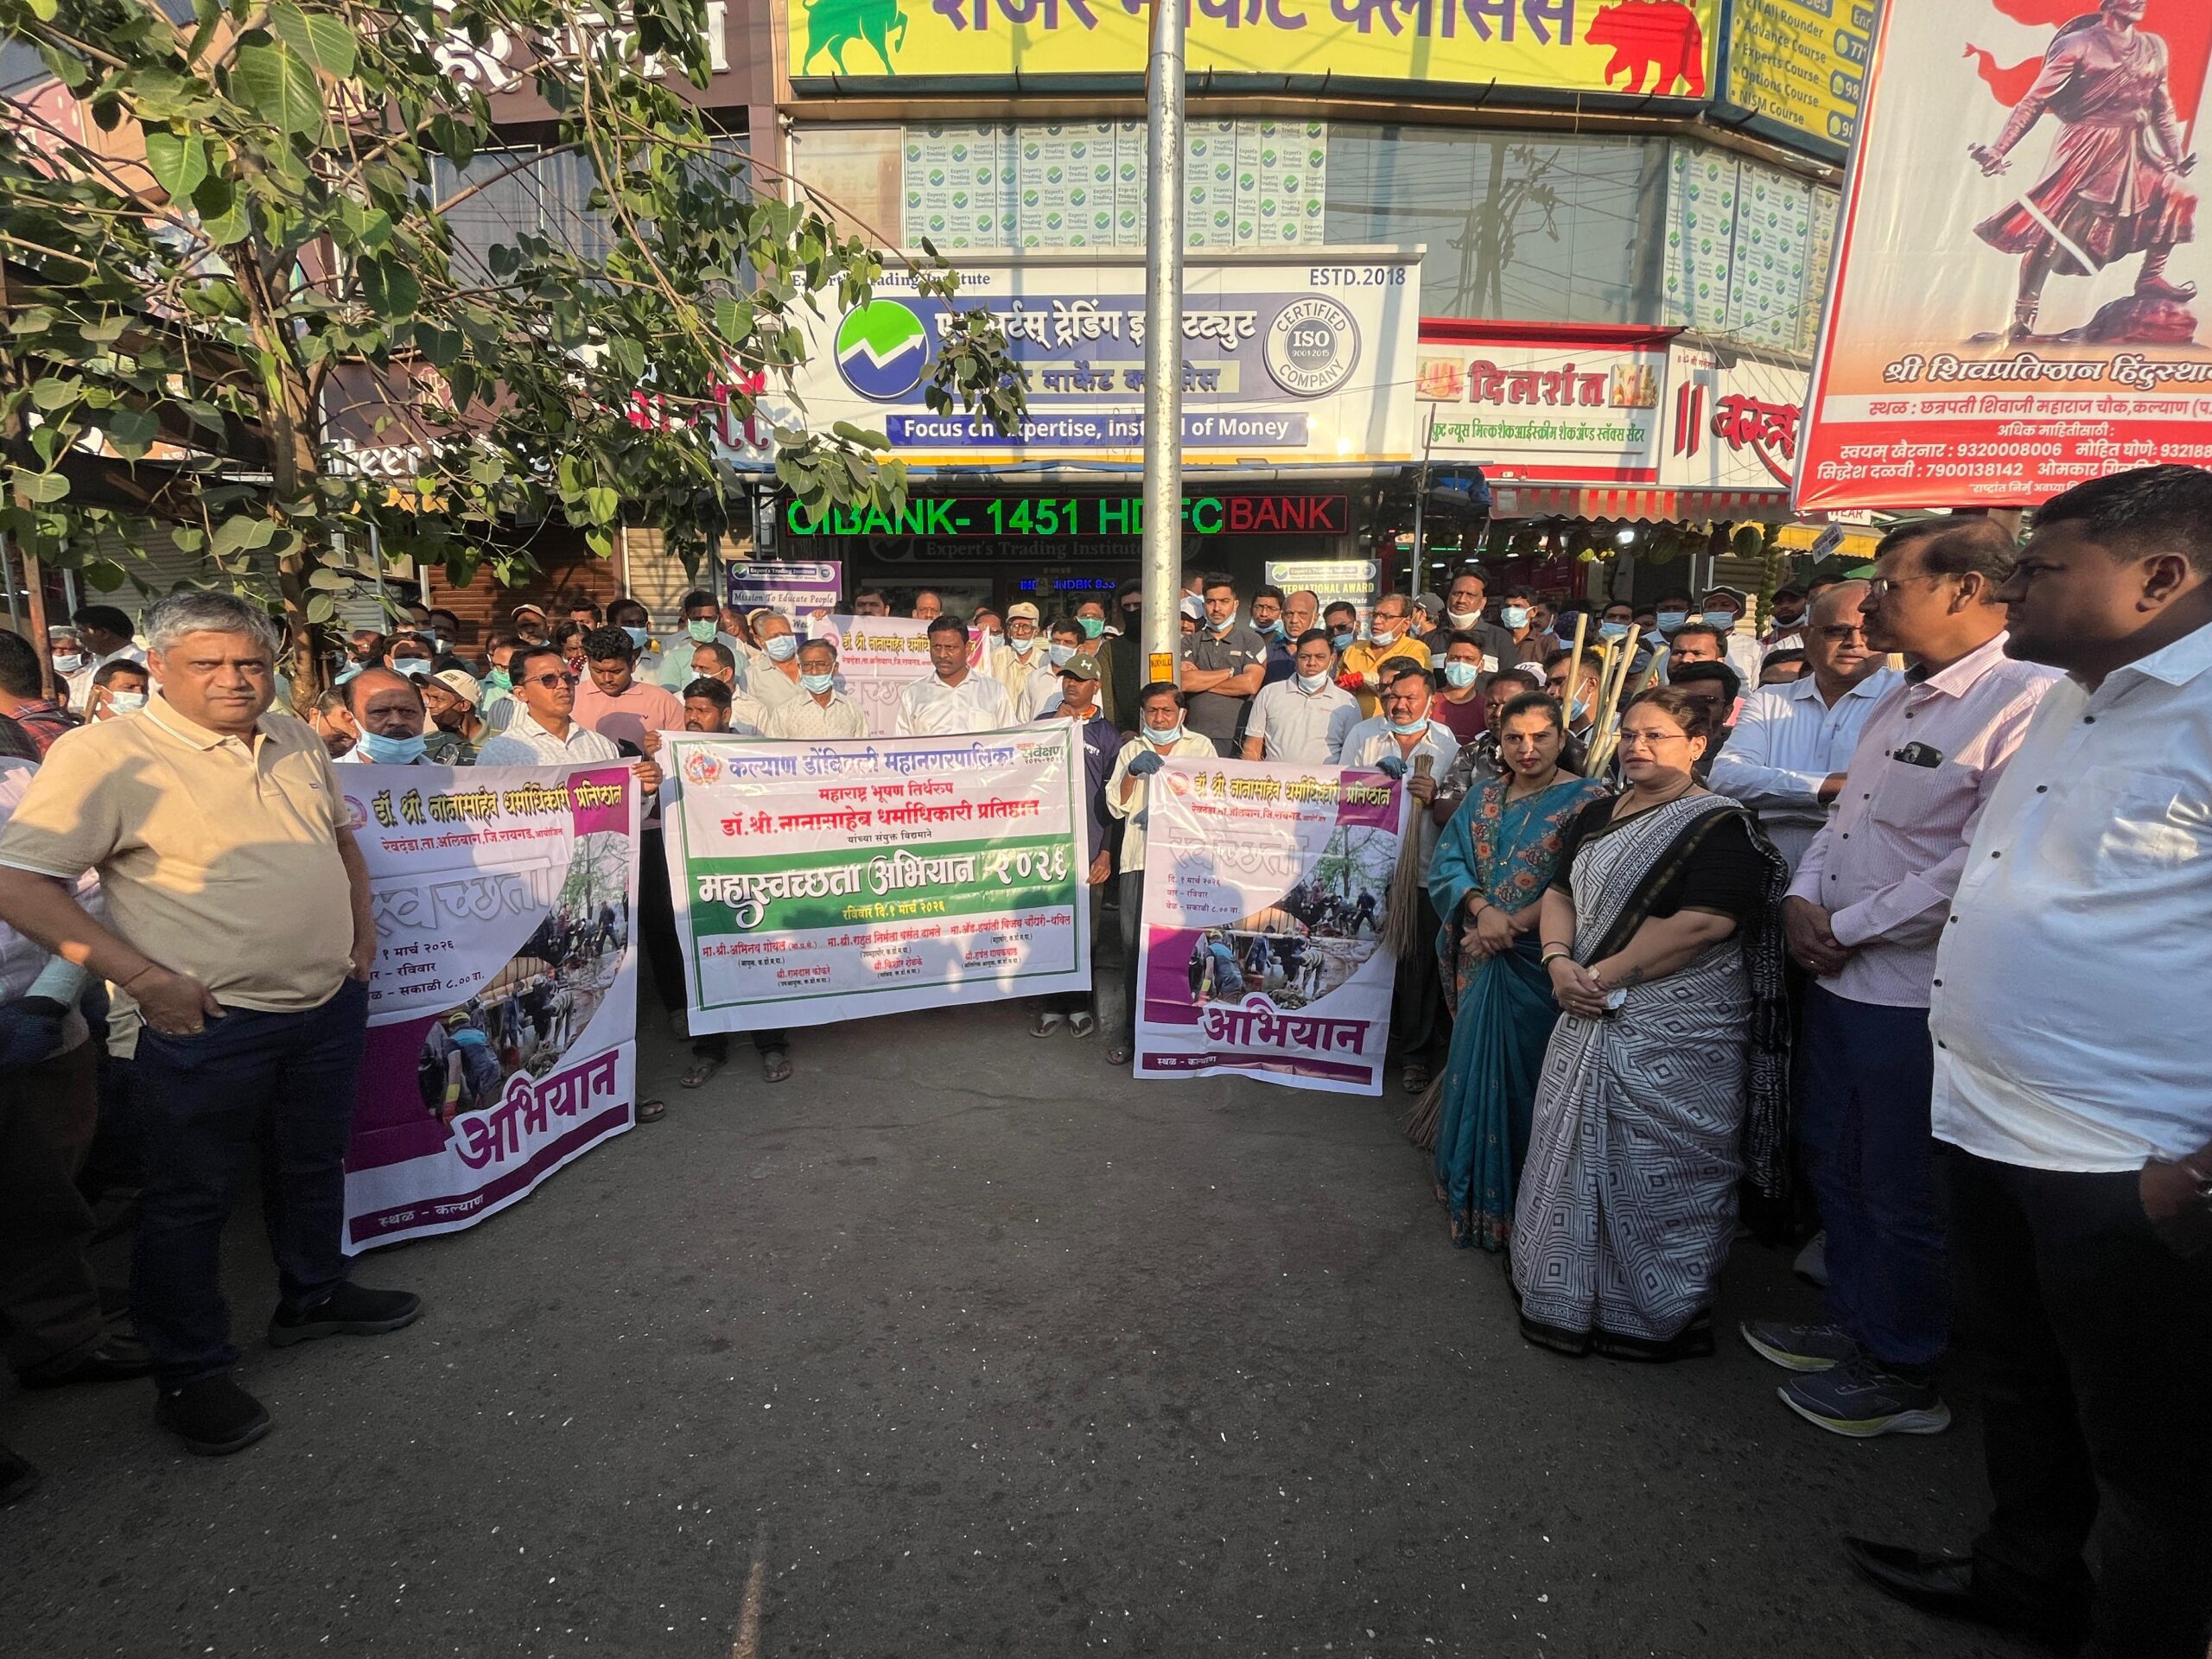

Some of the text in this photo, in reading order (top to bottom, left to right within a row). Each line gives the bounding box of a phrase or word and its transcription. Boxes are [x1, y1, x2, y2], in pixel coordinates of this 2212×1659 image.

[1764, 3, 1778, 20] All
[1780, 10, 1824, 39] Rounder
[1853, 10, 1872, 29] Enr
[1744, 19, 1827, 64] Advance Course
[1742, 42, 1820, 85] Experts Course
[1741, 67, 1820, 107] Options Course
[1739, 89, 1805, 125] NISM Course
[1310, 268, 1406, 286] ESTD.2018
[1052, 299, 1122, 347] ट्रेडिंग
[1277, 302, 1346, 333] CERTIFIED
[1293, 331, 1331, 347] ISO
[1042, 359, 1115, 391] मार्केट
[1279, 360, 1344, 388] COMPANY
[1885, 353, 1924, 383] श्री
[1929, 353, 2106, 383] शिवप्रतिष्ठान
[1869, 400, 1910, 416] स्थळ
[1920, 396, 1975, 415] छत्रपती
[1979, 395, 2033, 415] शिवाजी
[2037, 399, 2092, 415] महाराज
[904, 419, 963, 437] Focus
[1109, 418, 1185, 437] Inst
[1192, 418, 1213, 436] of
[1218, 418, 1289, 441] Money
[1997, 422, 2035, 437] अधिक
[1840, 444, 1888, 463] स्वयम्
[1956, 442, 2063, 458] 9320008006
[2075, 438, 2121, 457] मोहित
[1817, 461, 1868, 481] सिद्धेश
[1870, 459, 1915, 479] दळवी
[1926, 462, 2024, 478] 7900138142
[2037, 458, 2099, 477] ओमकार
[987, 499, 1077, 534] 1451
[1230, 498, 1332, 529] BANK
[925, 542, 995, 559] Expert's
[998, 542, 1067, 559] Trading
[734, 591, 833, 607] Mission To Educate People
[1277, 582, 1375, 594] NTERNATIONAL AWARD
[1339, 596, 1368, 605] Institute
[728, 753, 797, 778] कल्याण
[885, 741, 1014, 775] महानगरपालिका
[429, 785, 499, 827] नानासाहेब
[503, 781, 573, 818] धर्माधिकारी
[573, 779, 623, 810] प्रतिष्ठान
[819, 787, 868, 804] महाराष्ट्र
[871, 785, 904, 804] भूषण
[1230, 774, 1281, 808] नानासाहेब
[1345, 780, 1393, 810] प्रतिष्ठान
[878, 798, 972, 824] धर्माधिकारी
[977, 797, 1039, 819] प्रतिष्ठान
[696, 849, 1068, 930] महास्वच्छता अभियान २०२६
[1187, 888, 1208, 899] रविवार
[842, 905, 872, 920] रविवार
[921, 900, 945, 913] २०२६
[394, 941, 418, 957] मार्च
[423, 940, 454, 954] २०२६
[397, 962, 436, 977] रविवार
[399, 978, 442, 996] सकाळी
[1204, 998, 1370, 1056] अभियान
[1157, 1057, 1177, 1065] स्थळ
[455, 1049, 620, 1171] अभियान
[378, 1192, 485, 1229] स्थळ कल्याण
